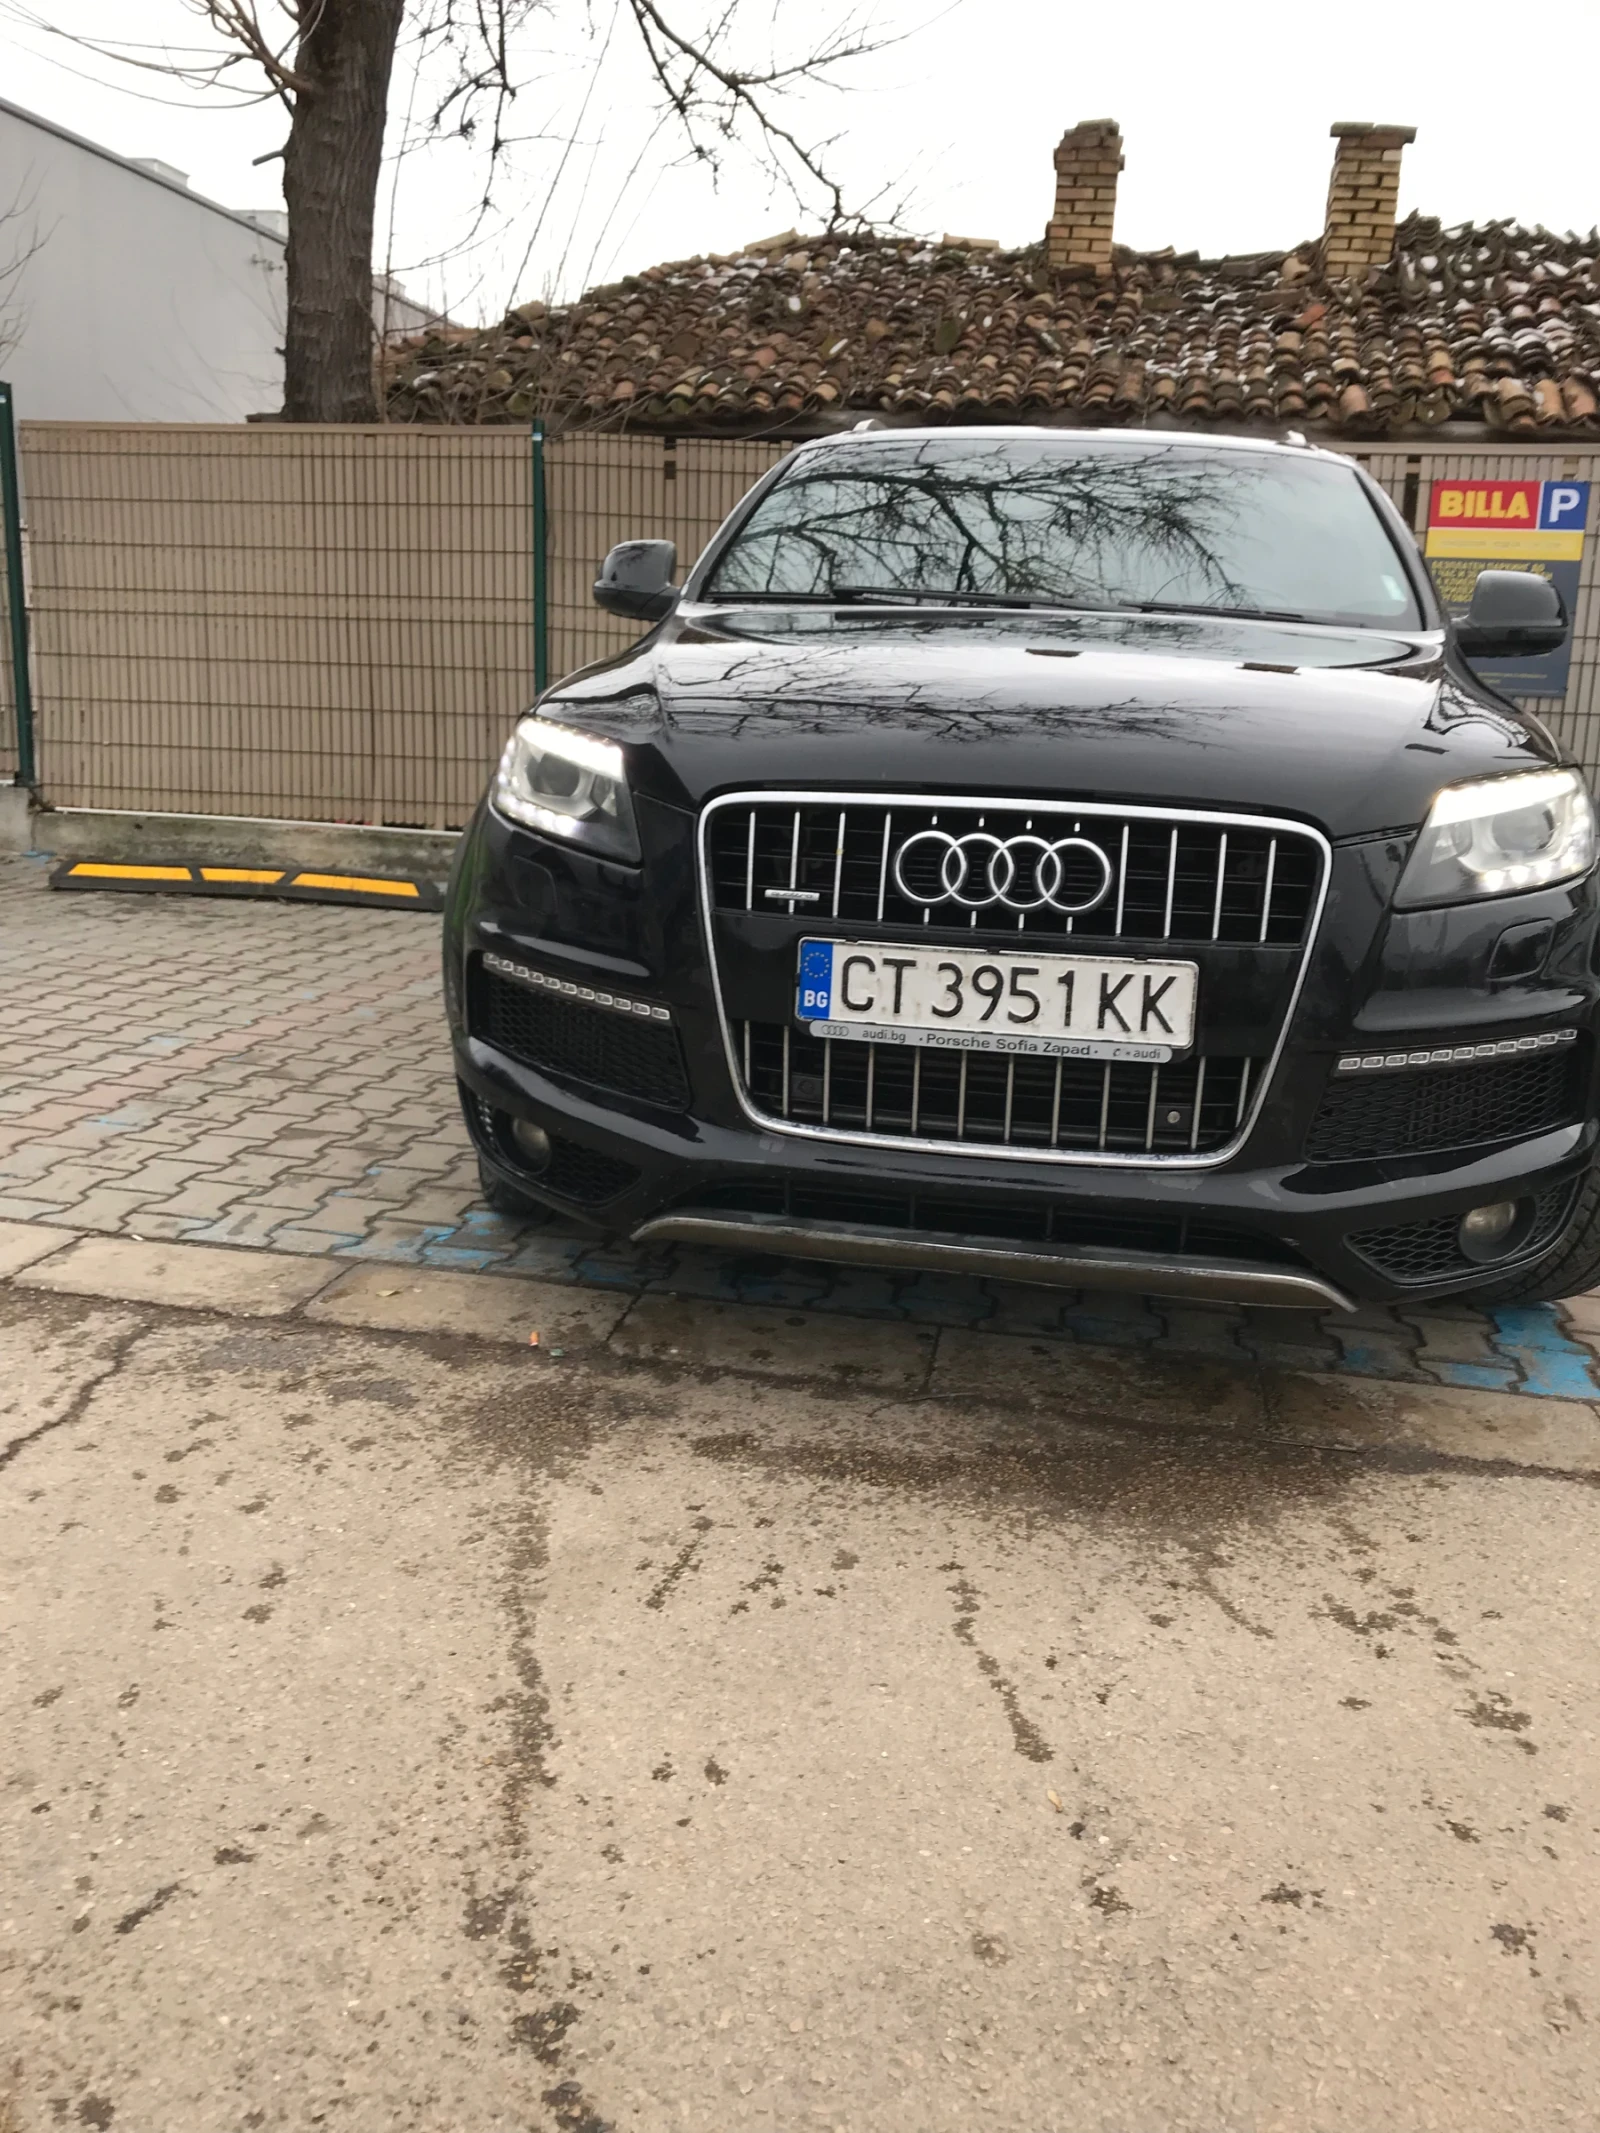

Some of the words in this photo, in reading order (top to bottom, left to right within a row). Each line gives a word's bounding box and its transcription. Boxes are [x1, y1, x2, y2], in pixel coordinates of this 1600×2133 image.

[1439, 490, 1530, 519] BILLA
[1549, 488, 1580, 523] P
[803, 989, 828, 1008] BG
[841, 955, 917, 1014] CT
[931, 962, 1076, 1027] 3951
[1096, 972, 1177, 1034] KK
[862, 1028, 907, 1044] audi.bg
[926, 1033, 991, 1050] Porsche
[995, 1037, 1038, 1053] Sofia
[1042, 1041, 1091, 1056] Zapad
